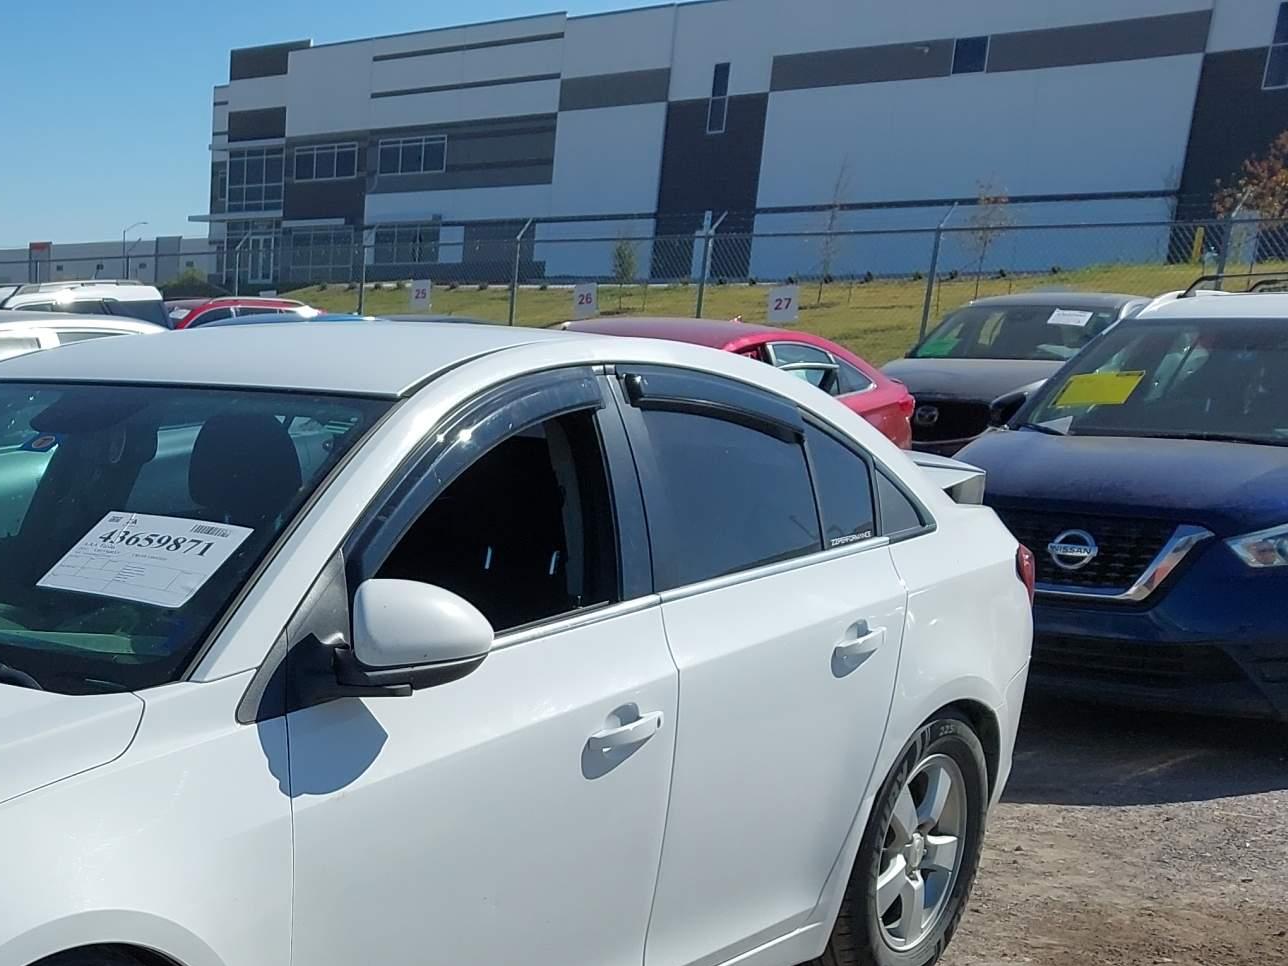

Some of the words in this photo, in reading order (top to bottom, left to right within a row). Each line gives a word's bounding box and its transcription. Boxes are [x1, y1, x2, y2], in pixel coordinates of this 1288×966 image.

[415, 288, 427, 299] 25
[578, 292, 593, 305] 26
[774, 297, 792, 311] 27
[98, 527, 215, 557] 43659871
[1049, 545, 1092, 555] NISSAN
